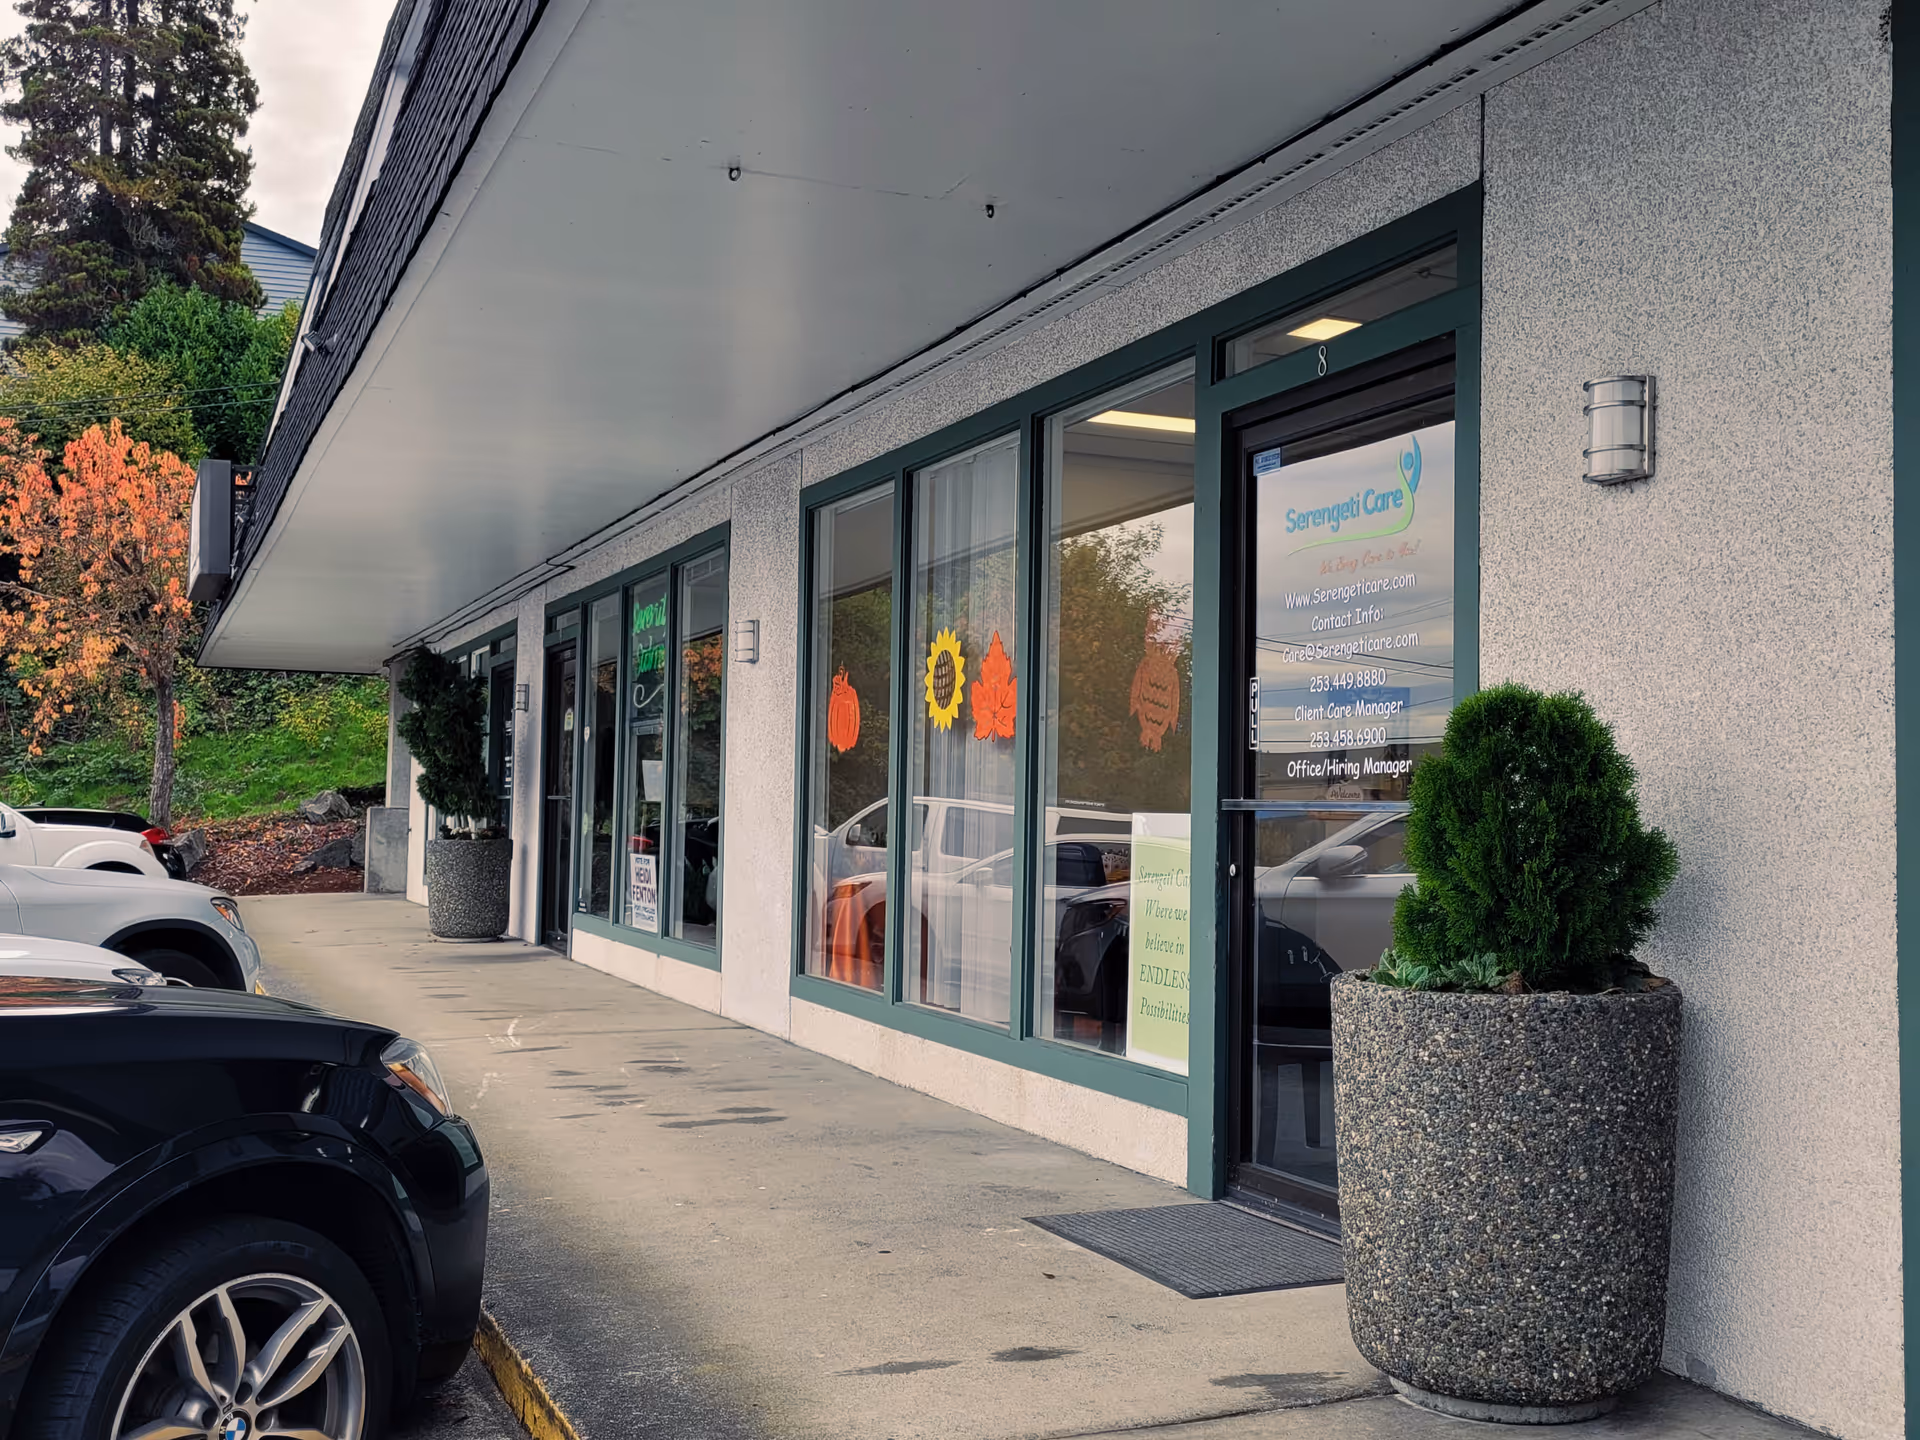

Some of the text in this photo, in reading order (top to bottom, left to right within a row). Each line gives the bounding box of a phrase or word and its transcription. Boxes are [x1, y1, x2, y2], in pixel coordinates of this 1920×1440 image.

[1318, 345, 1327, 376] 8
[1285, 487, 1404, 533] Serengeti Care
[1284, 572, 1416, 609] Www.Serengeticare.com
[1311, 604, 1385, 632] Contact Info:
[1282, 632, 1419, 663] Care@Serengeticare.com
[1309, 667, 1387, 693] 253.449.8880
[1294, 699, 1404, 722] Client Care Manager
[1309, 727, 1387, 748] 253.458.6900
[1287, 757, 1413, 780] Office/Hiring Manager
[635, 866, 652, 885] HEIDI
[1139, 865, 1190, 891] Serengeti Ca
[632, 884, 656, 905] FENTON
[1145, 899, 1188, 921] Where we
[1145, 932, 1185, 955] believe in
